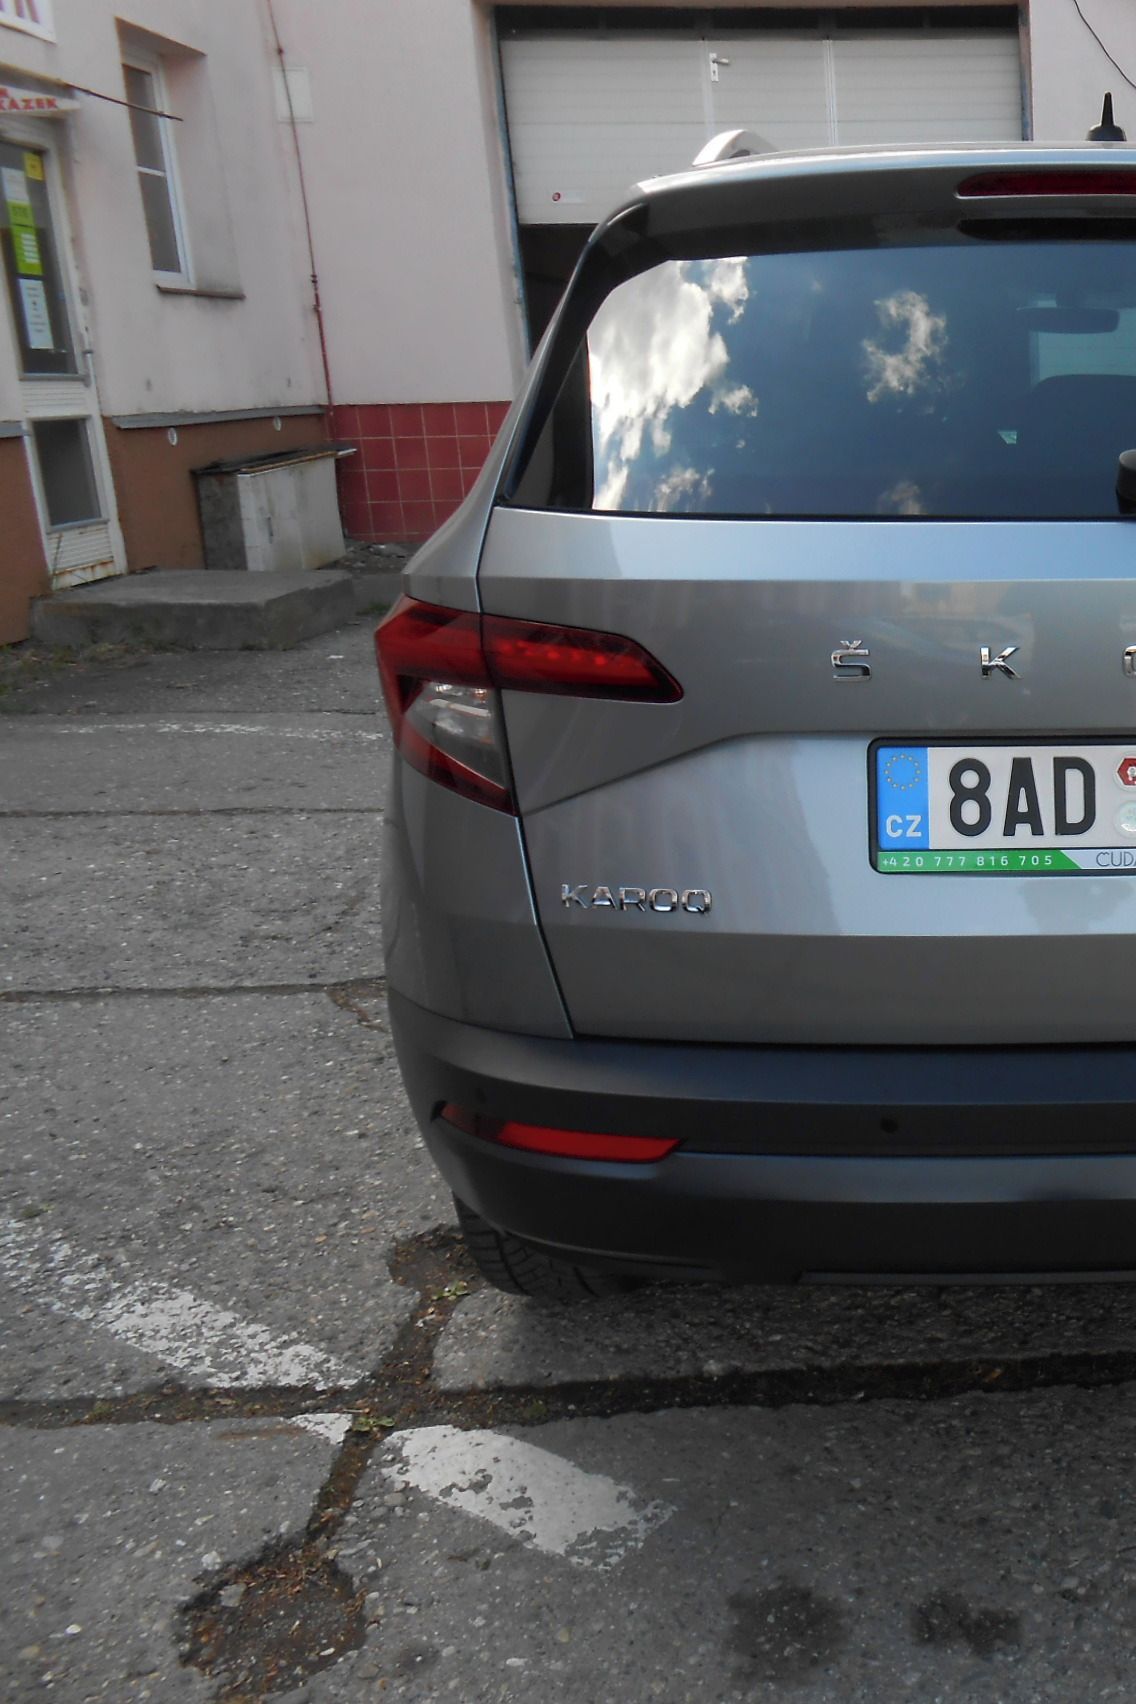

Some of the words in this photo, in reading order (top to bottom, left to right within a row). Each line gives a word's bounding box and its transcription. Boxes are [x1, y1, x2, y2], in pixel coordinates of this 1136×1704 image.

[949, 756, 1096, 838] 8AD
[885, 814, 922, 838] CZ
[882, 855, 924, 868] +420
[934, 855, 967, 867] 777
[976, 855, 1009, 867] 816
[1018, 854, 1053, 866] 705
[561, 883, 713, 914] KAROQ
